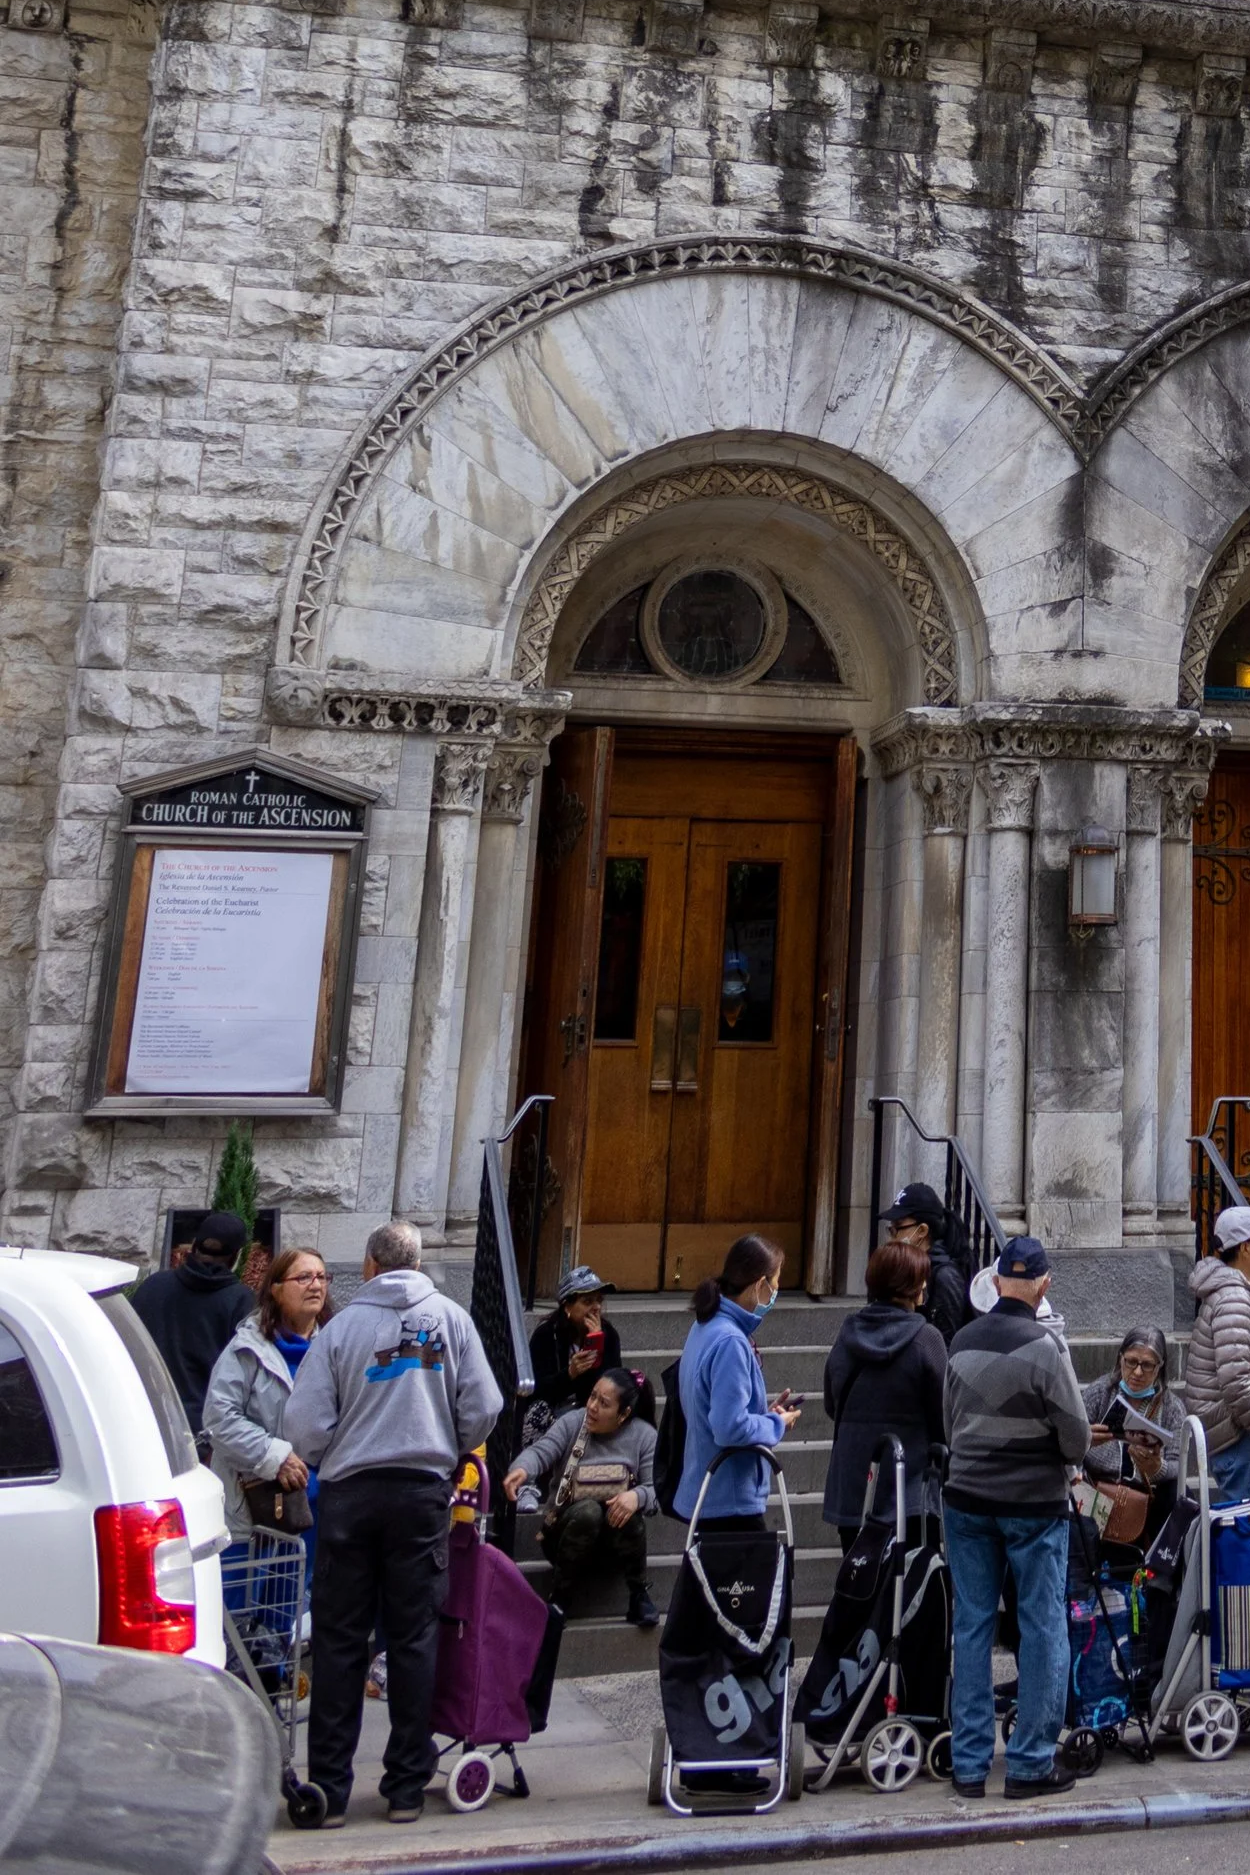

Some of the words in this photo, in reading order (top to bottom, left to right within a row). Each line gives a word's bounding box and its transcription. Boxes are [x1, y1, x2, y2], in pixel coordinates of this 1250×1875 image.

[190, 791, 238, 805] ROMAN
[242, 793, 306, 808] CATHOLIC
[141, 803, 209, 823] CHURCH
[211, 810, 228, 824] OF
[231, 811, 256, 825] THE
[258, 807, 352, 827] ASCENSION
[159, 872, 185, 881] Iglesia
[186, 872, 196, 880] de
[197, 873, 205, 881] la
[156, 896, 200, 906] Celebration
[201, 897, 210, 906] of
[211, 898, 223, 906] the
[224, 898, 259, 907] Eucharist
[155, 906, 201, 915] Celebración
[202, 906, 212, 915] de
[213, 907, 221, 916] la
